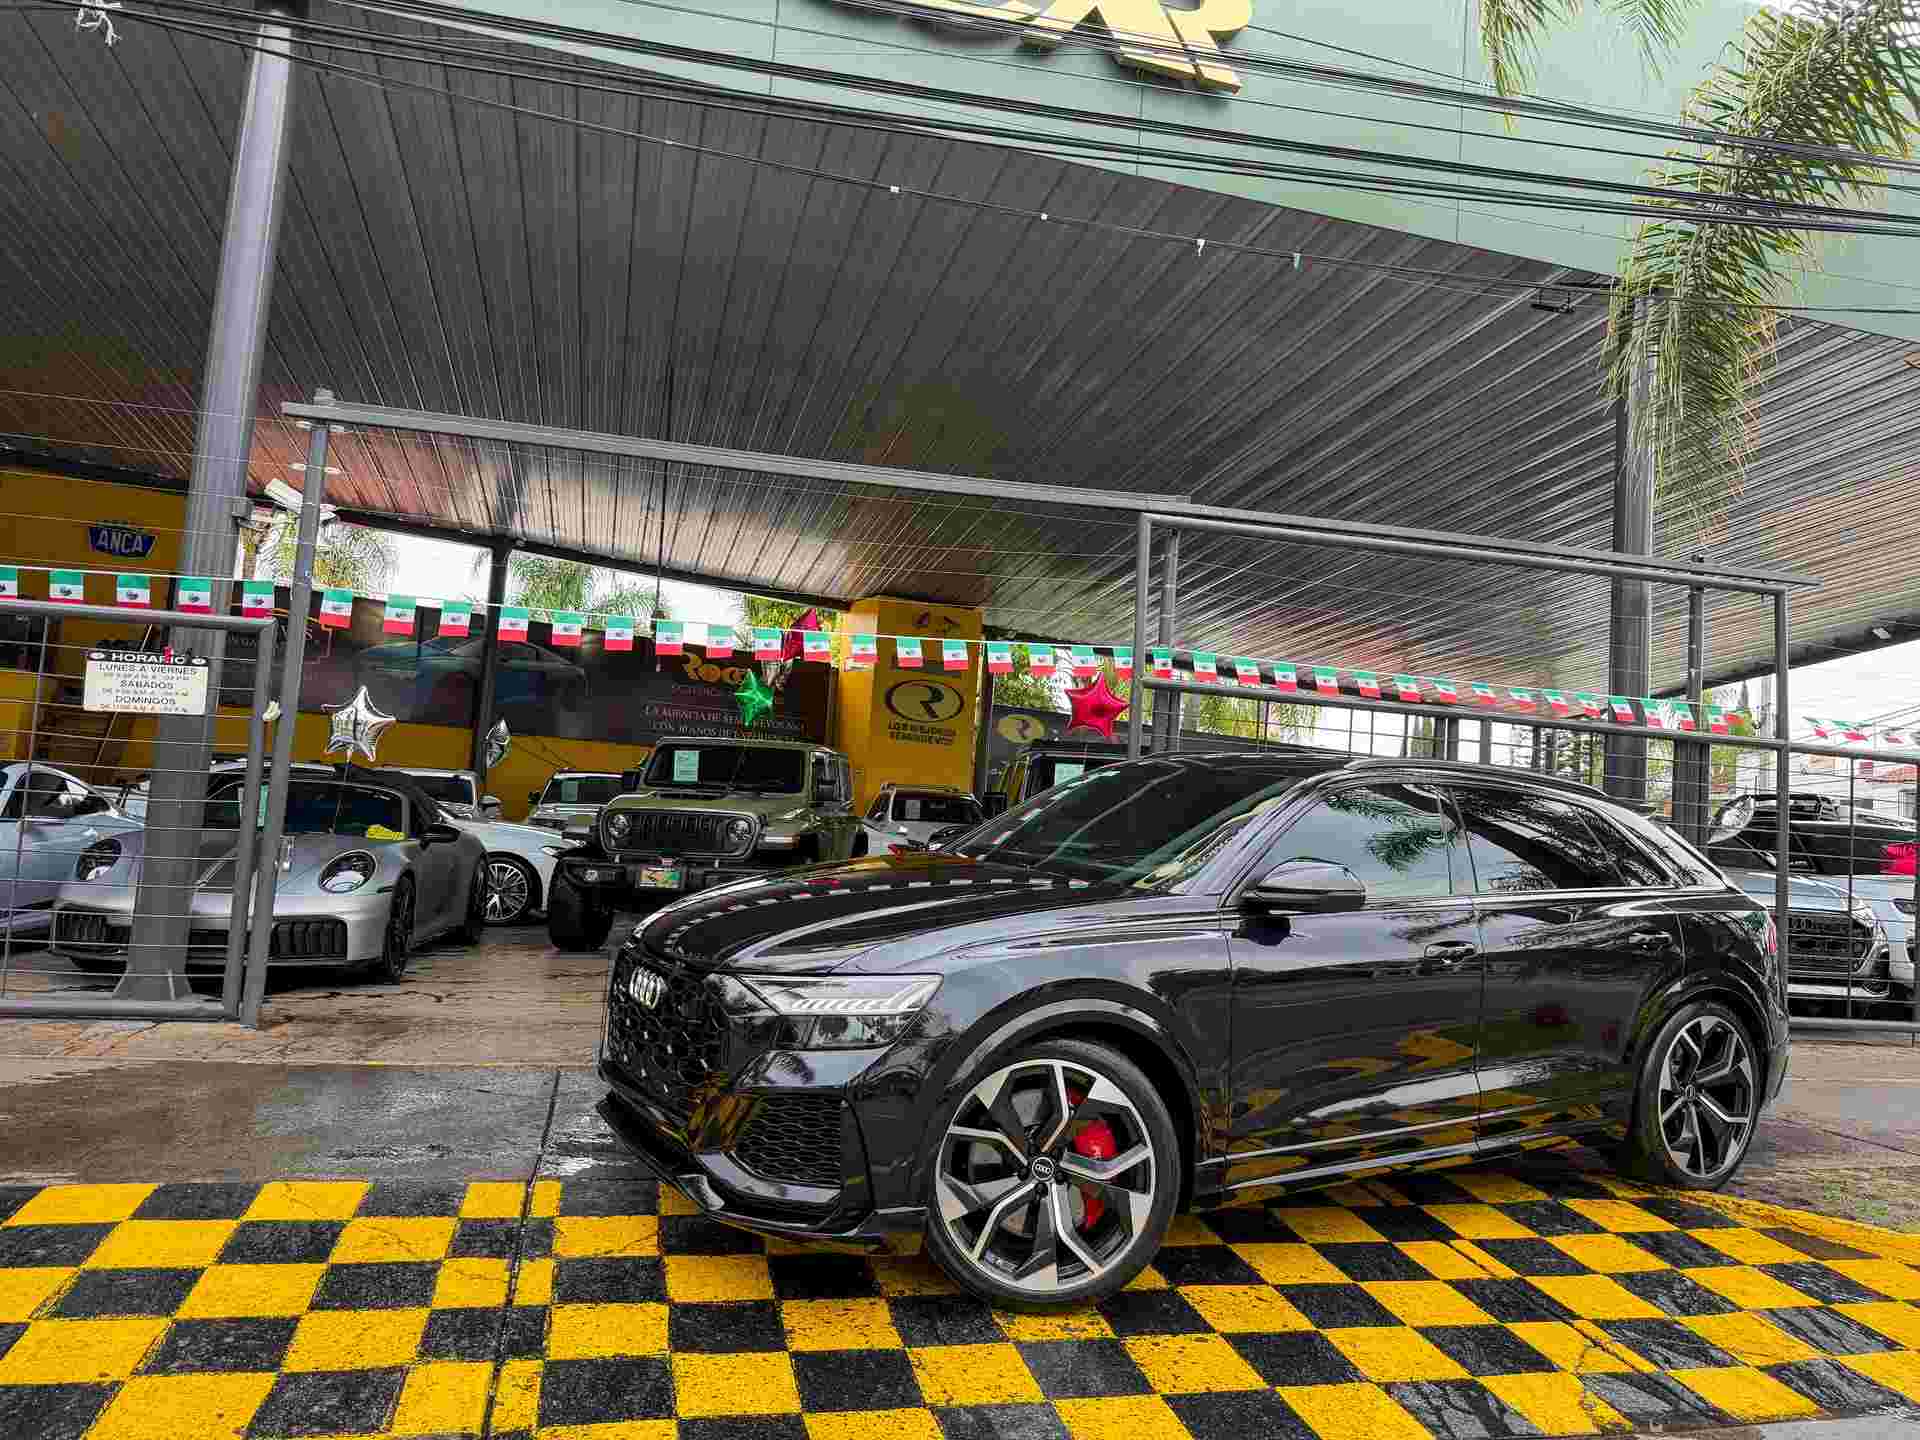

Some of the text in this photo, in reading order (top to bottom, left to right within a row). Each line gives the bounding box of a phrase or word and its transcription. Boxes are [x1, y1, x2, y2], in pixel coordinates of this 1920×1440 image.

[98, 528, 144, 553] ANCA
[98, 663, 197, 675] LUNES A VIERNES
[115, 695, 176, 705] DOMINGOS
